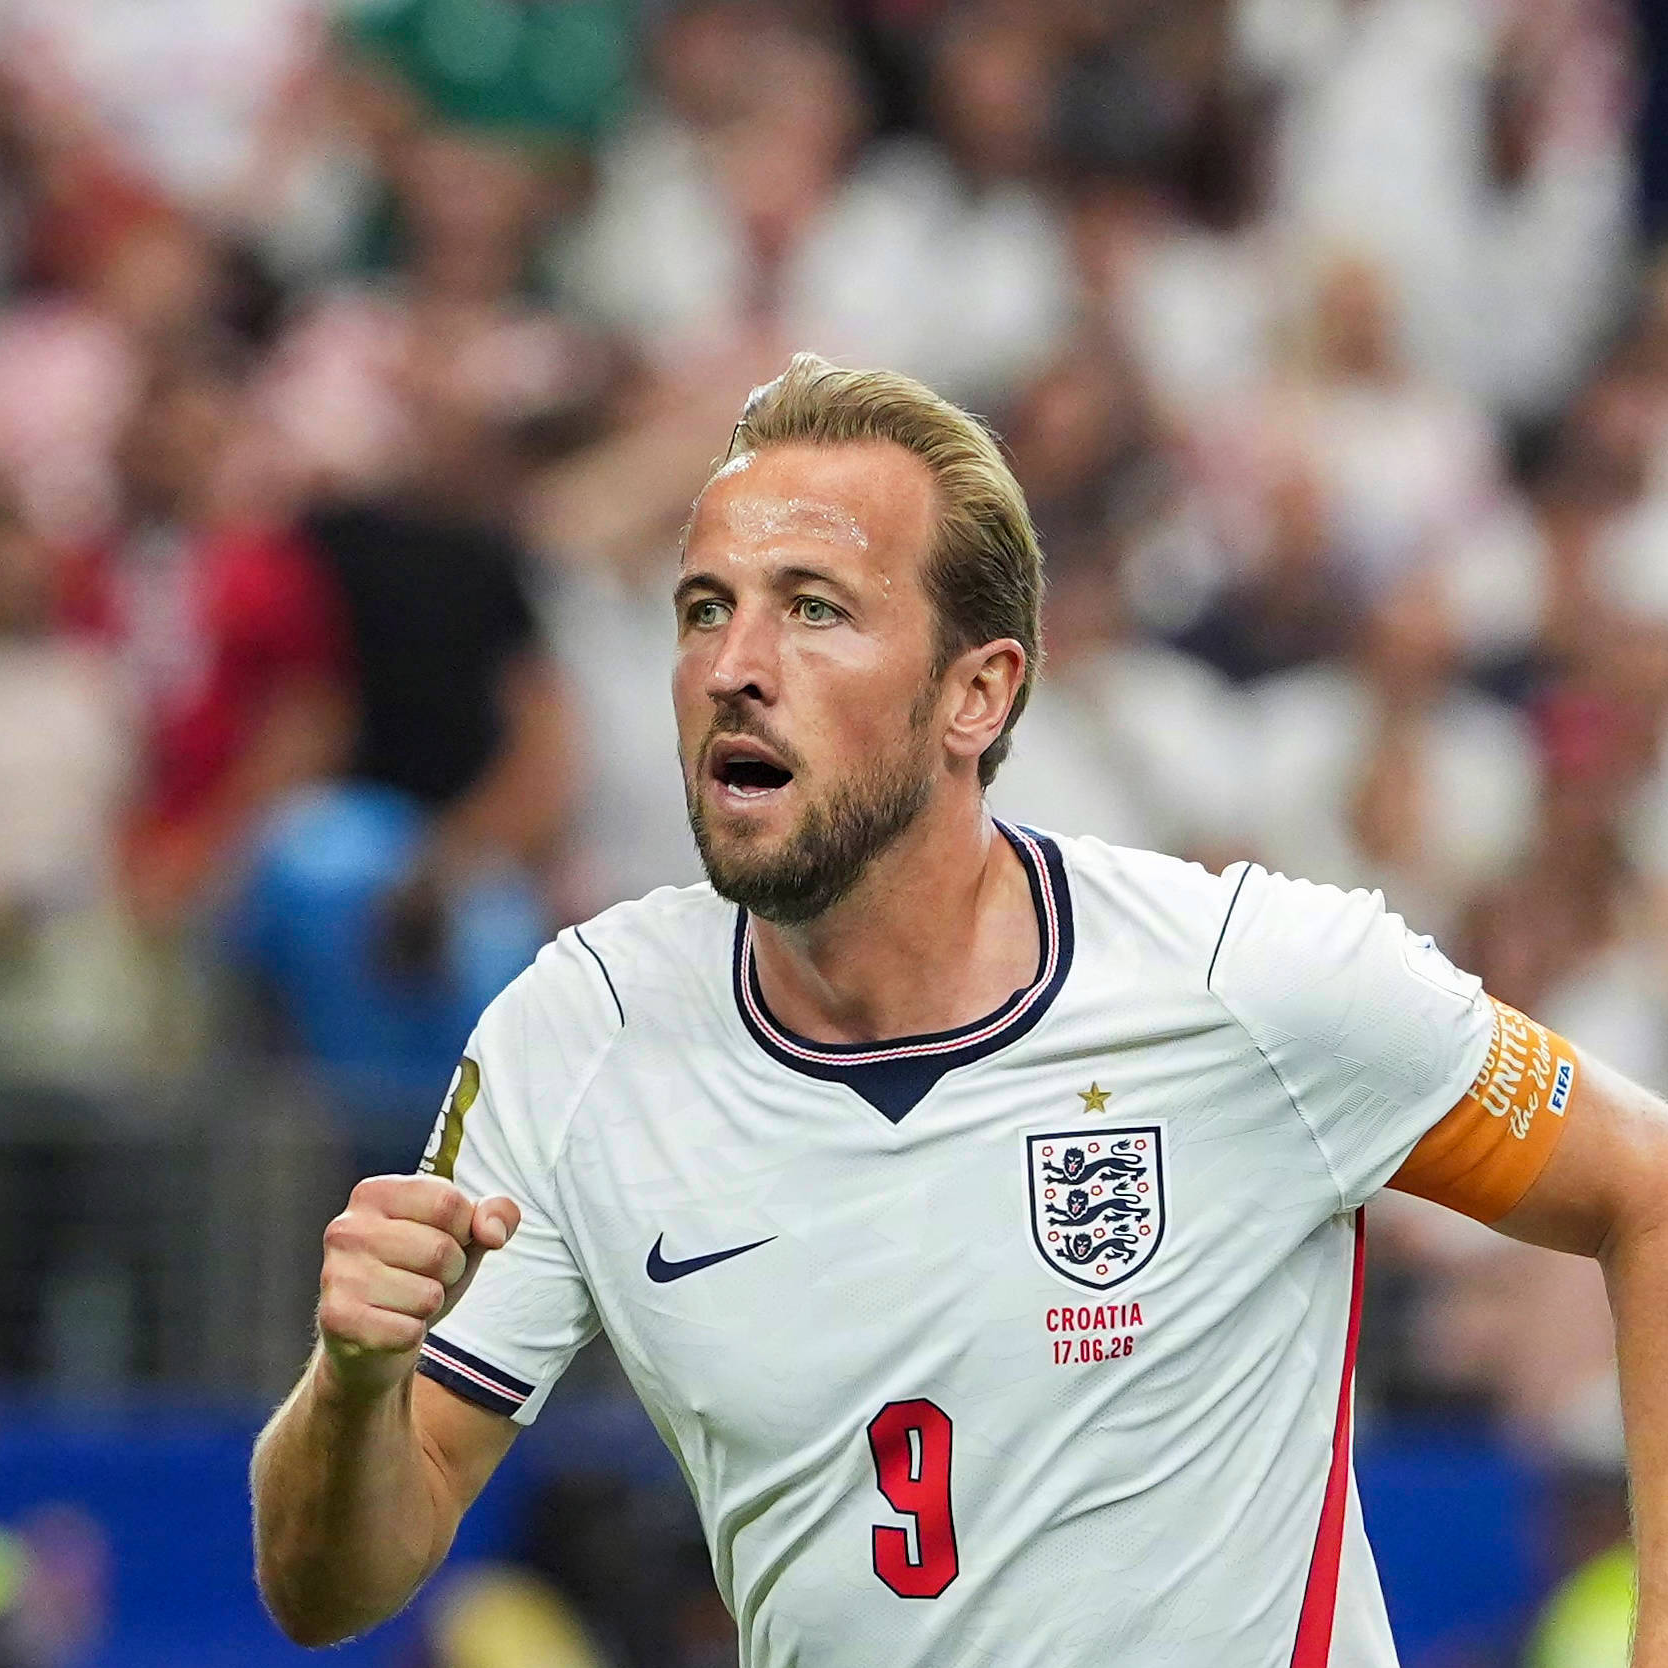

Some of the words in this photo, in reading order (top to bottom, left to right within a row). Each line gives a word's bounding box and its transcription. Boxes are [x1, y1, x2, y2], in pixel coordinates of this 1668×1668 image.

[1551, 1065, 1571, 1110] FIFA
[1508, 1091, 1539, 1139] the
[1045, 1302, 1144, 1333] CROATIA
[1052, 1335, 1134, 1365] 17.06.26
[866, 1397, 960, 1600] 9
